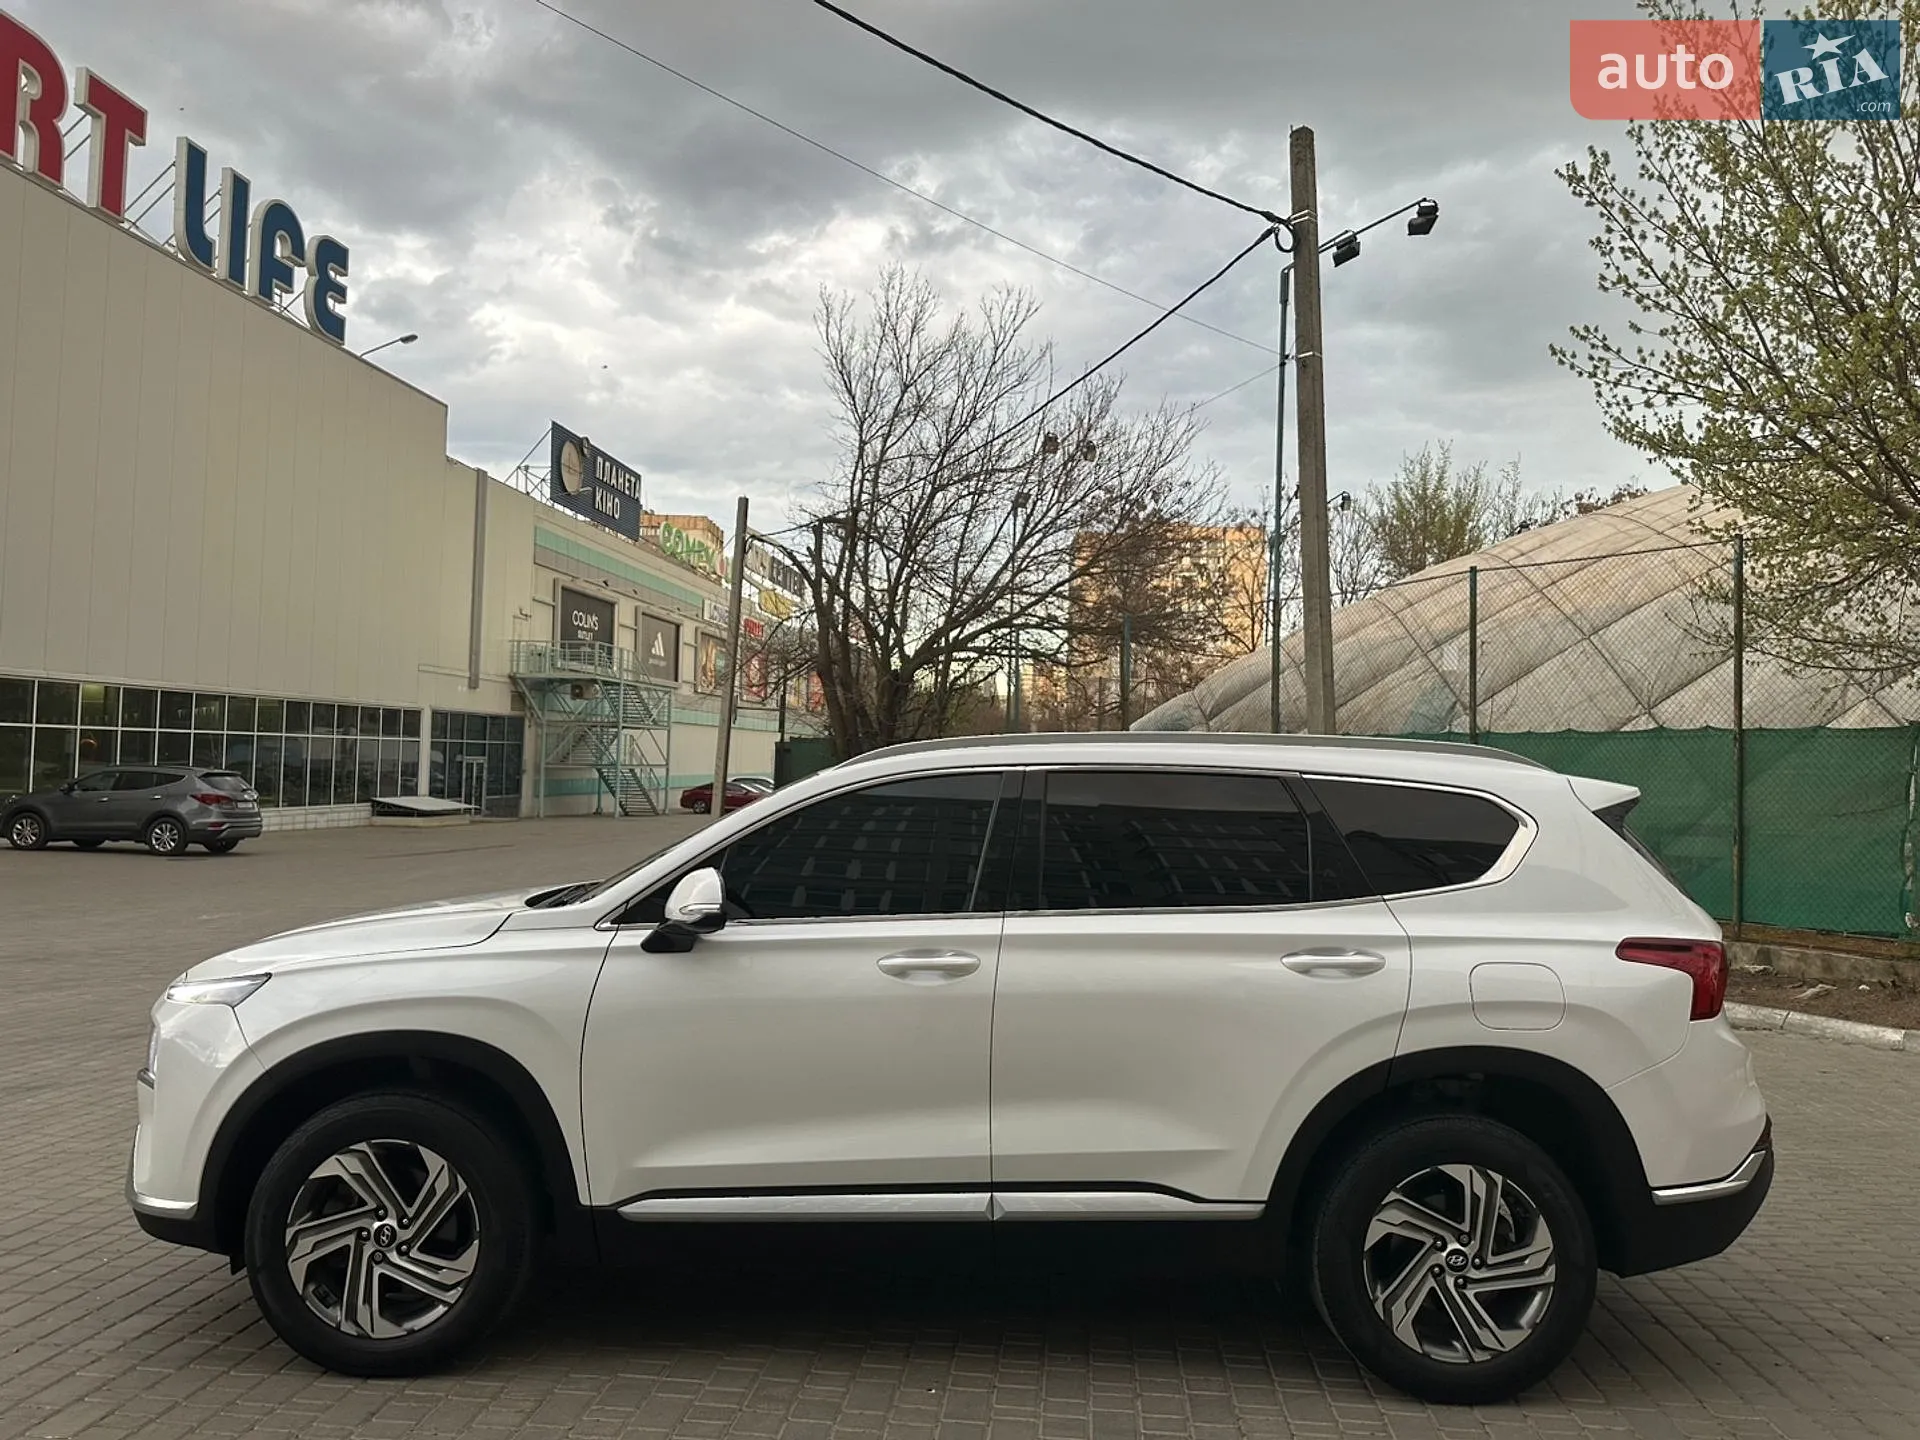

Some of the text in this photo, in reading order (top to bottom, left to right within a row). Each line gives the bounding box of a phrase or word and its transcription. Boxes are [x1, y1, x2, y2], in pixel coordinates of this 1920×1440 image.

[173, 136, 350, 346] LIFE
[595, 455, 640, 500] ПЛАНЕТА
[594, 486, 620, 520] КІНО
